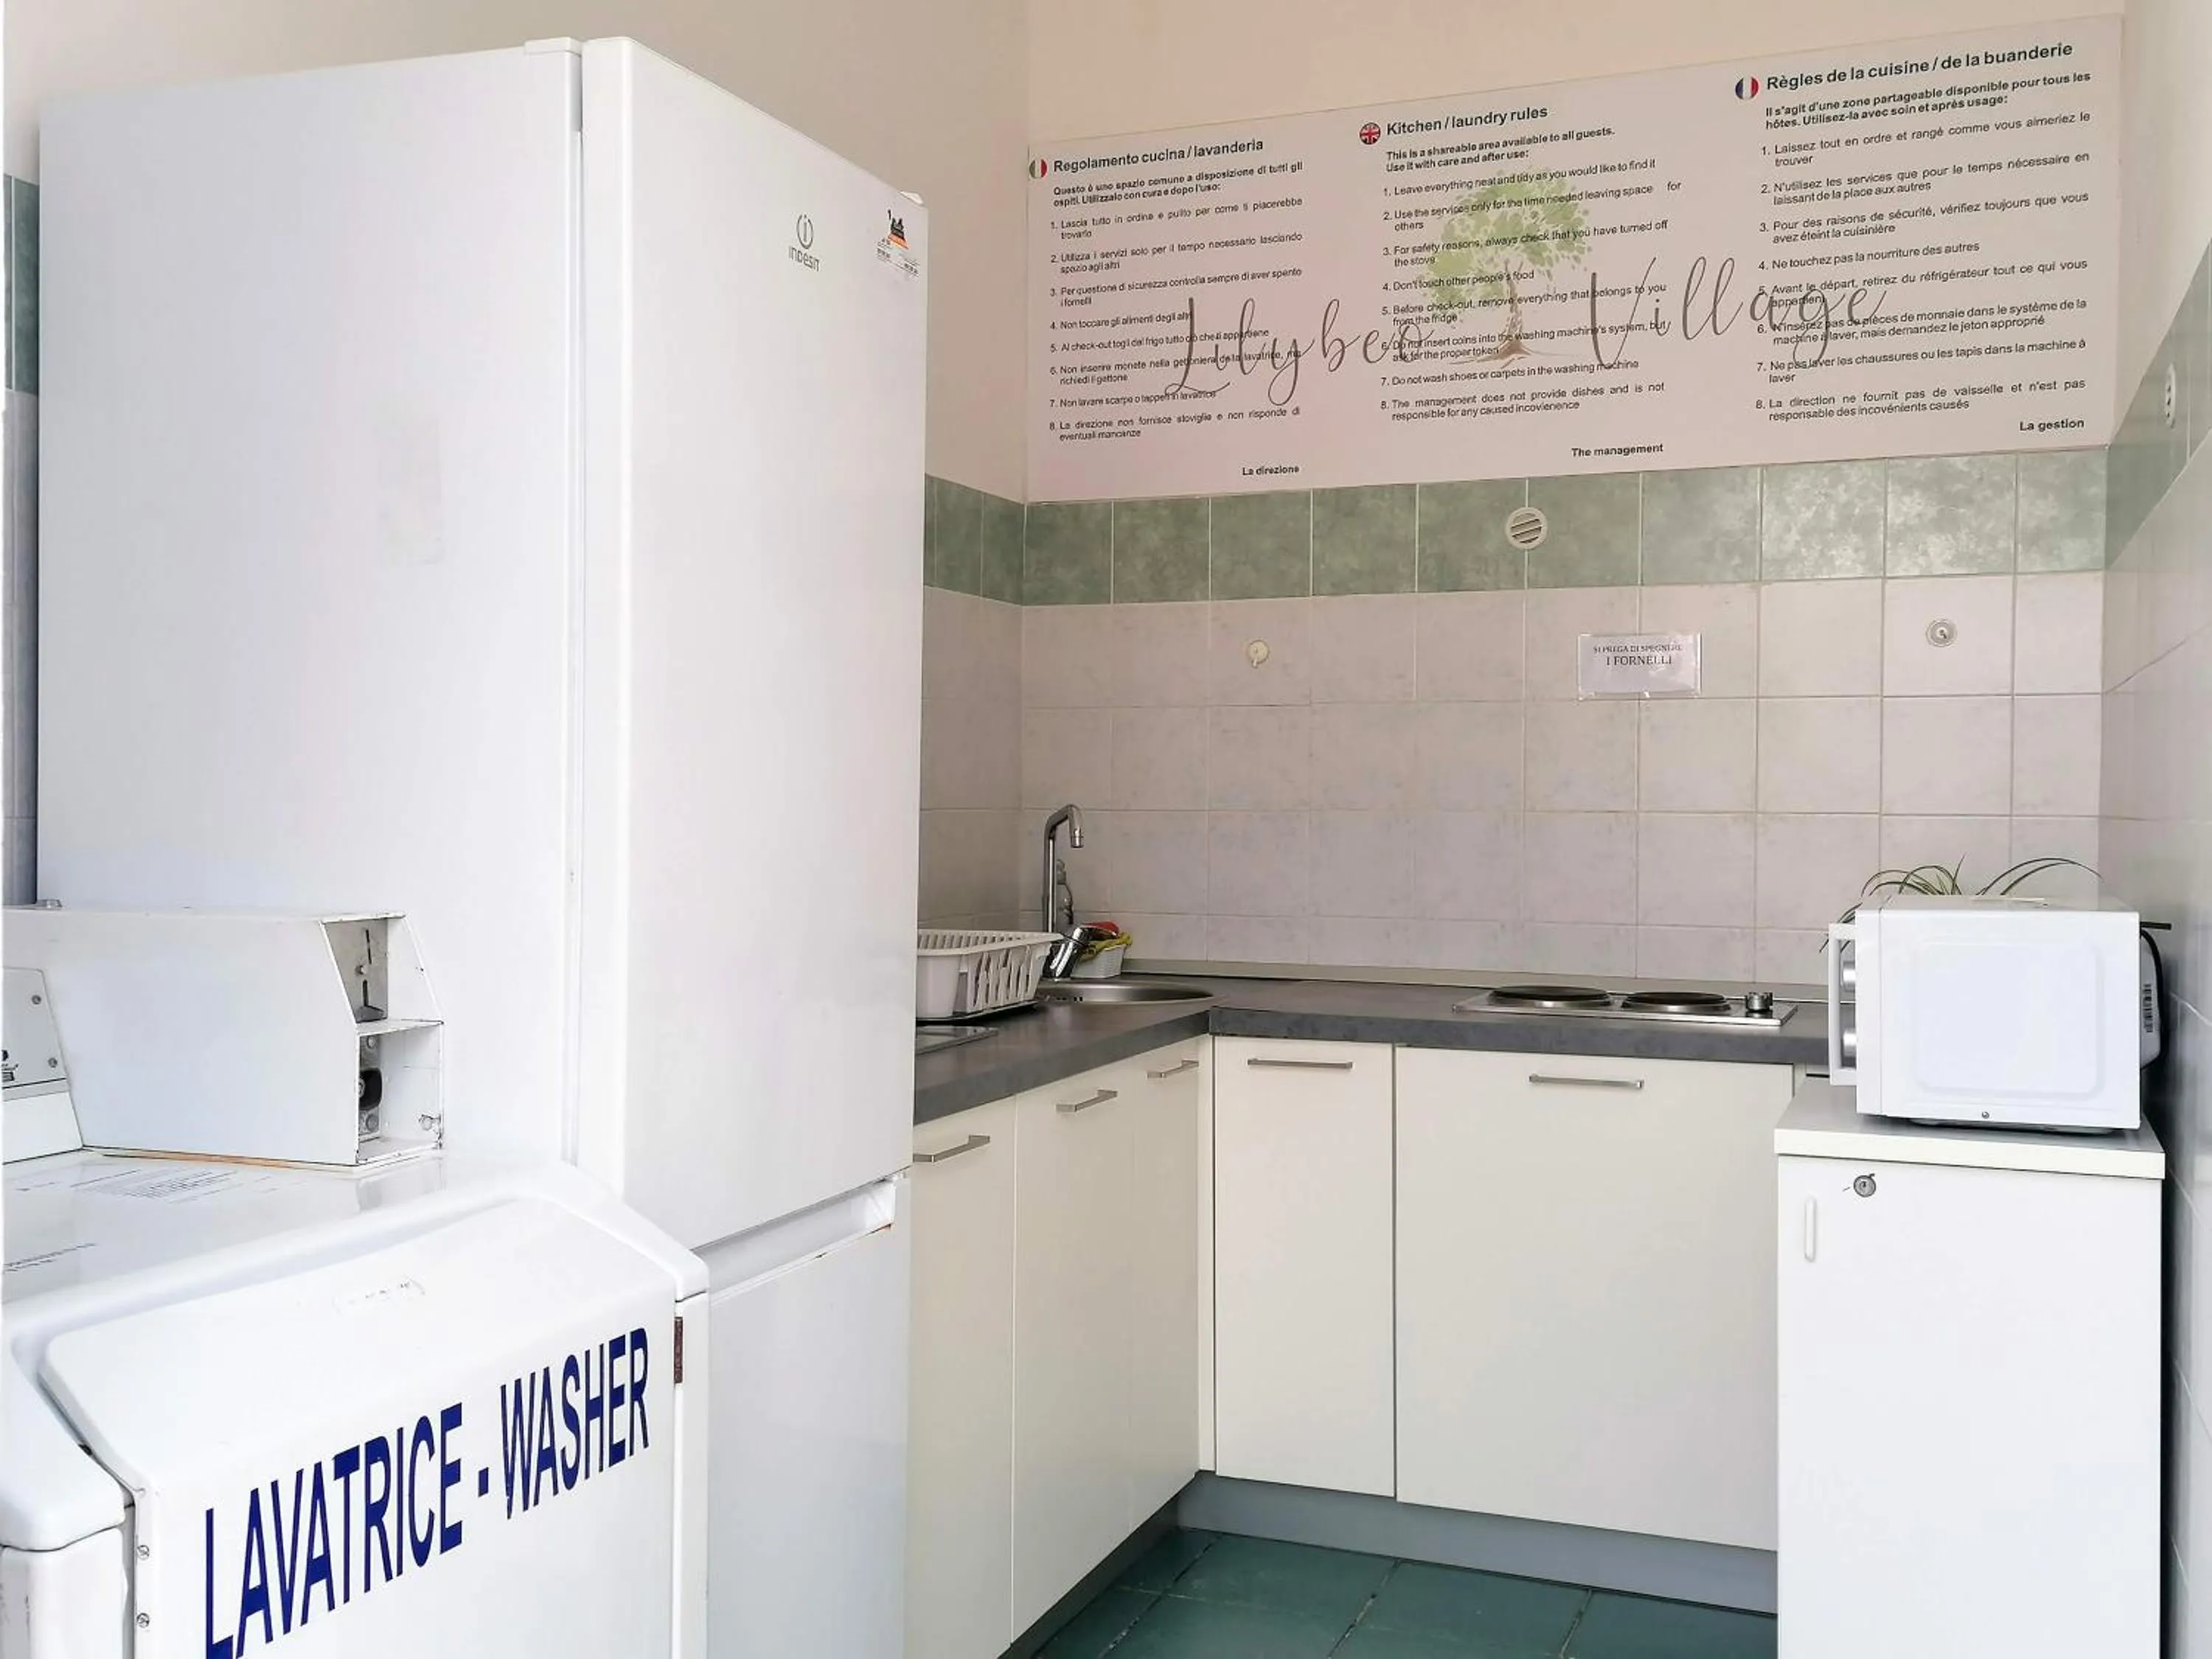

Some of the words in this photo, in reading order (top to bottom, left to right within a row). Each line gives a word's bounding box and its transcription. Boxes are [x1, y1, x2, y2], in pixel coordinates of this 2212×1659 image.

[1767, 72, 1823, 89] Règles
[1826, 69, 1847, 83] de
[1849, 66, 1865, 80] la
[1867, 60, 1929, 77] cuisine
[1940, 56, 1962, 69] de
[1964, 54, 1981, 67] la
[1983, 44, 2073, 65] buanderie
[1767, 106, 1773, 117] Il
[1774, 103, 1806, 116] s'agit
[1807, 101, 1840, 112] d'une
[1841, 97, 1871, 108] zone
[1872, 88, 1943, 107] partageable
[1945, 80, 2008, 97] disponible
[2011, 78, 2039, 91] pour
[2042, 75, 2070, 86] tous
[2072, 72, 2091, 83] les
[1385, 119, 1441, 135] Kitchen
[1451, 111, 1507, 128] laundry
[1509, 108, 1548, 122] rules
[1802, 110, 1860, 125] Utilisez-la
[1860, 108, 1888, 119] avec
[1890, 104, 1916, 116] soin
[1917, 102, 1930, 113] et
[1930, 98, 1965, 112] après
[1386, 149, 1408, 160] This
[1408, 148, 1418, 158] is
[1419, 149, 1426, 157] a
[1426, 142, 1477, 156] shareable
[1478, 141, 1500, 150] area
[1501, 134, 1548, 147] available
[1548, 133, 1559, 142] to
[1561, 130, 1574, 141] all
[1774, 142, 1817, 154] Laissez
[1818, 138, 1841, 150] tout
[1843, 137, 1859, 147] en
[1861, 133, 1893, 145] ordre
[1895, 131, 1907, 141] et
[1910, 125, 1944, 139] rangé
[1947, 123, 1990, 136] comme
[1993, 120, 2023, 131] vous
[2025, 114, 2076, 127] aimeriez
[2079, 111, 2090, 122] le
[1053, 153, 1139, 173] Regolamento
[1141, 148, 1185, 163] cucina
[1193, 139, 1263, 158] lavanderia
[1387, 162, 1405, 173] Use
[1405, 161, 1413, 170] it
[1414, 158, 1436, 170] with
[1436, 157, 1459, 167] care
[1460, 153, 1480, 164] and
[1481, 152, 1505, 162] after
[1775, 155, 1817, 167] trouver
[1825, 177, 1843, 187] les
[1846, 173, 1893, 185] services
[1896, 170, 1918, 182] que
[1921, 167, 1949, 180] pour
[1951, 164, 1963, 175] le
[1966, 161, 2003, 173] temps
[2006, 154, 2070, 169] nécessaire
[2073, 153, 2090, 162] en
[1394, 185, 1423, 195] Leave
[1423, 179, 1474, 192] everything
[1474, 176, 1496, 187] neat
[1496, 173, 1516, 185] and
[1516, 172, 1534, 184] tidy
[1534, 172, 1548, 181] as
[1548, 170, 1567, 181] you
[1568, 164, 1598, 177] would
[1599, 163, 1616, 173] like
[1617, 162, 1627, 172] to
[1628, 159, 1648, 170] find
[1649, 158, 1655, 168] it
[1774, 192, 1815, 206] laissant
[1815, 190, 1830, 201] de
[1831, 189, 1842, 200] la
[1843, 187, 1873, 201] place
[1874, 185, 1895, 195] aux
[1896, 181, 1932, 193] autres
[1392, 245, 1410, 255] For
[1411, 243, 1441, 254] safety
[1484, 236, 1518, 246] always
[1519, 231, 1549, 243] check
[1551, 229, 1571, 240] that
[1571, 229, 1590, 240] you
[1592, 226, 1617, 236] have
[1619, 220, 1652, 233] turned
[1654, 219, 1669, 229] off
[1771, 259, 1788, 269] Ne
[1789, 255, 1832, 268] touchez
[1832, 254, 1854, 265] pas
[1854, 251, 1865, 262] la
[1865, 248, 1920, 260] nourriture
[1921, 246, 1942, 256] des
[1944, 243, 1980, 254] autres
[1590, 256, 1887, 369] Village
[2020, 420, 2034, 431] La
[2037, 419, 2084, 432] gestion
[1571, 447, 1591, 457] The
[1593, 443, 1663, 456] management
[1242, 465, 1254, 476] La
[1255, 465, 1299, 475] direzione
[1606, 655, 1611, 666] I
[1613, 655, 1673, 666] FORNELLI
[205, 1402, 463, 1659] LAVATRICE
[500, 1327, 650, 1520] WASHER
